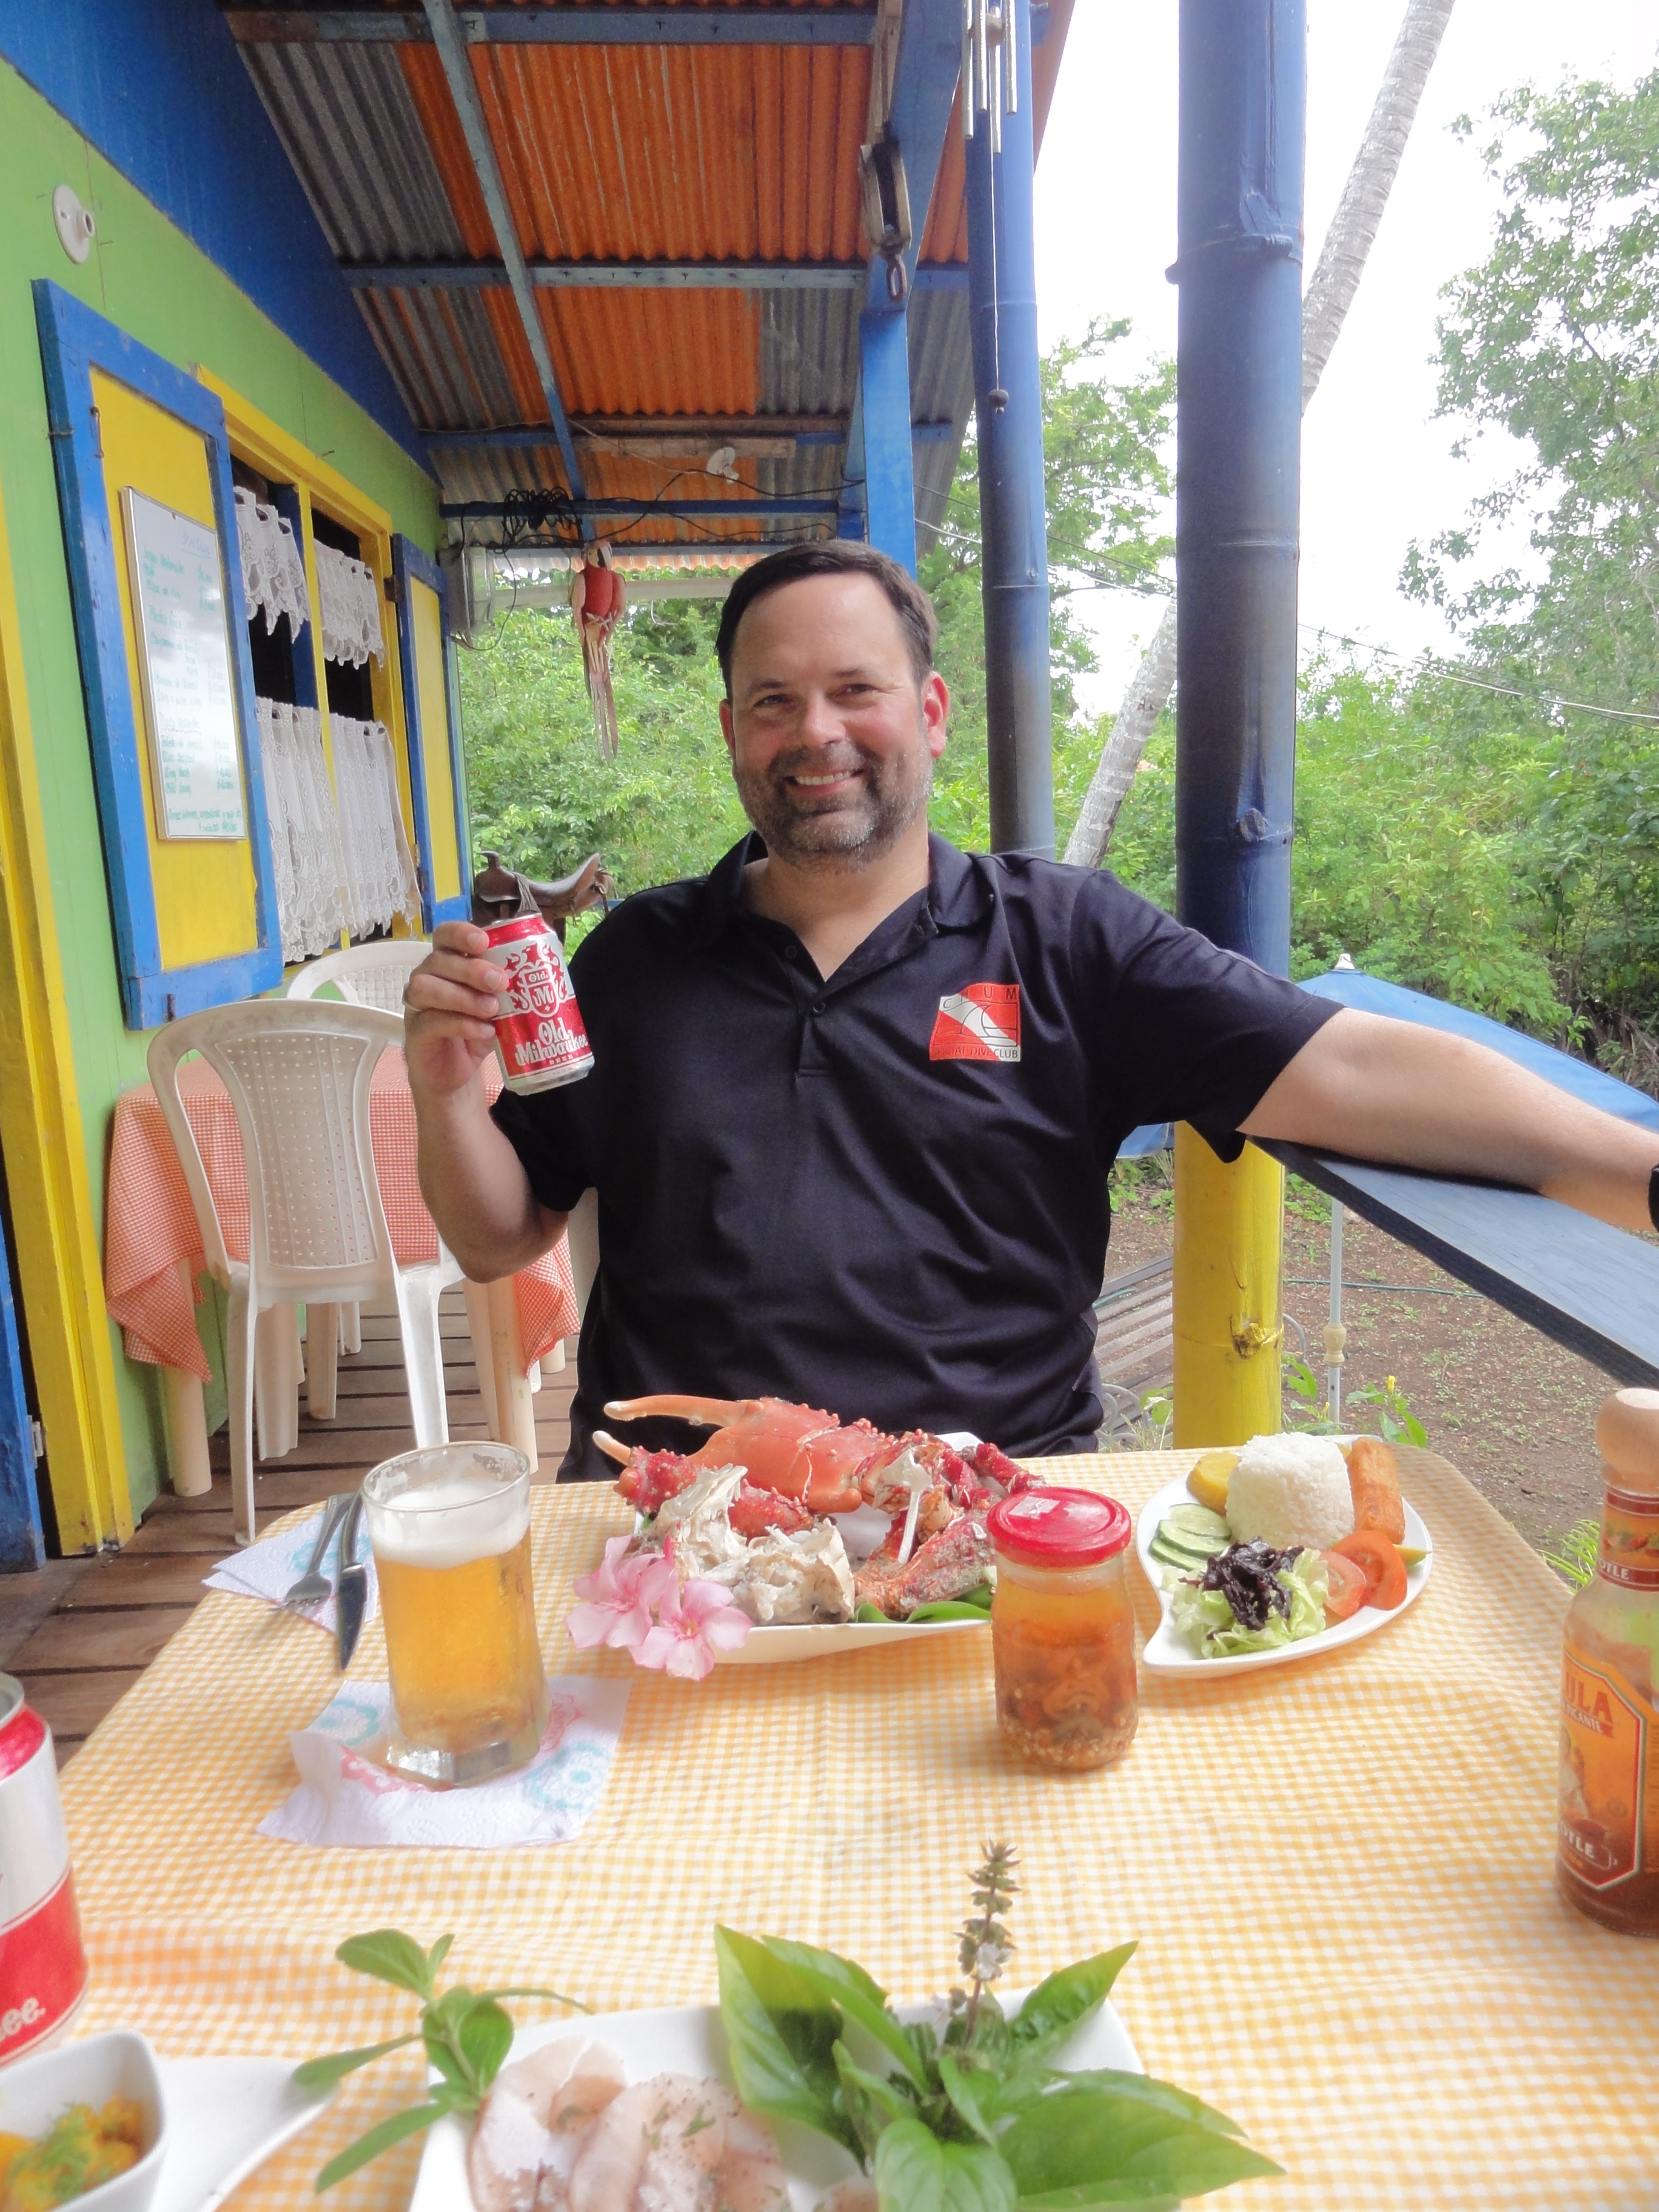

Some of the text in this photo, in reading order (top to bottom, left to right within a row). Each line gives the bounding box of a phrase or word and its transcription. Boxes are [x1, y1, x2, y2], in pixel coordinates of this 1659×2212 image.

[529, 971, 548, 982] Old
[532, 985, 554, 1006] M
[943, 985, 1017, 1009] CHUM
[538, 1017, 569, 1045] Old
[515, 1029, 588, 1066] Milwaukee
[970, 1047, 991, 1056] DIVE
[994, 1048, 1018, 1059] CLUB
[549, 1054, 573, 1065] BEER
[0, 1997, 47, 2042] ee
